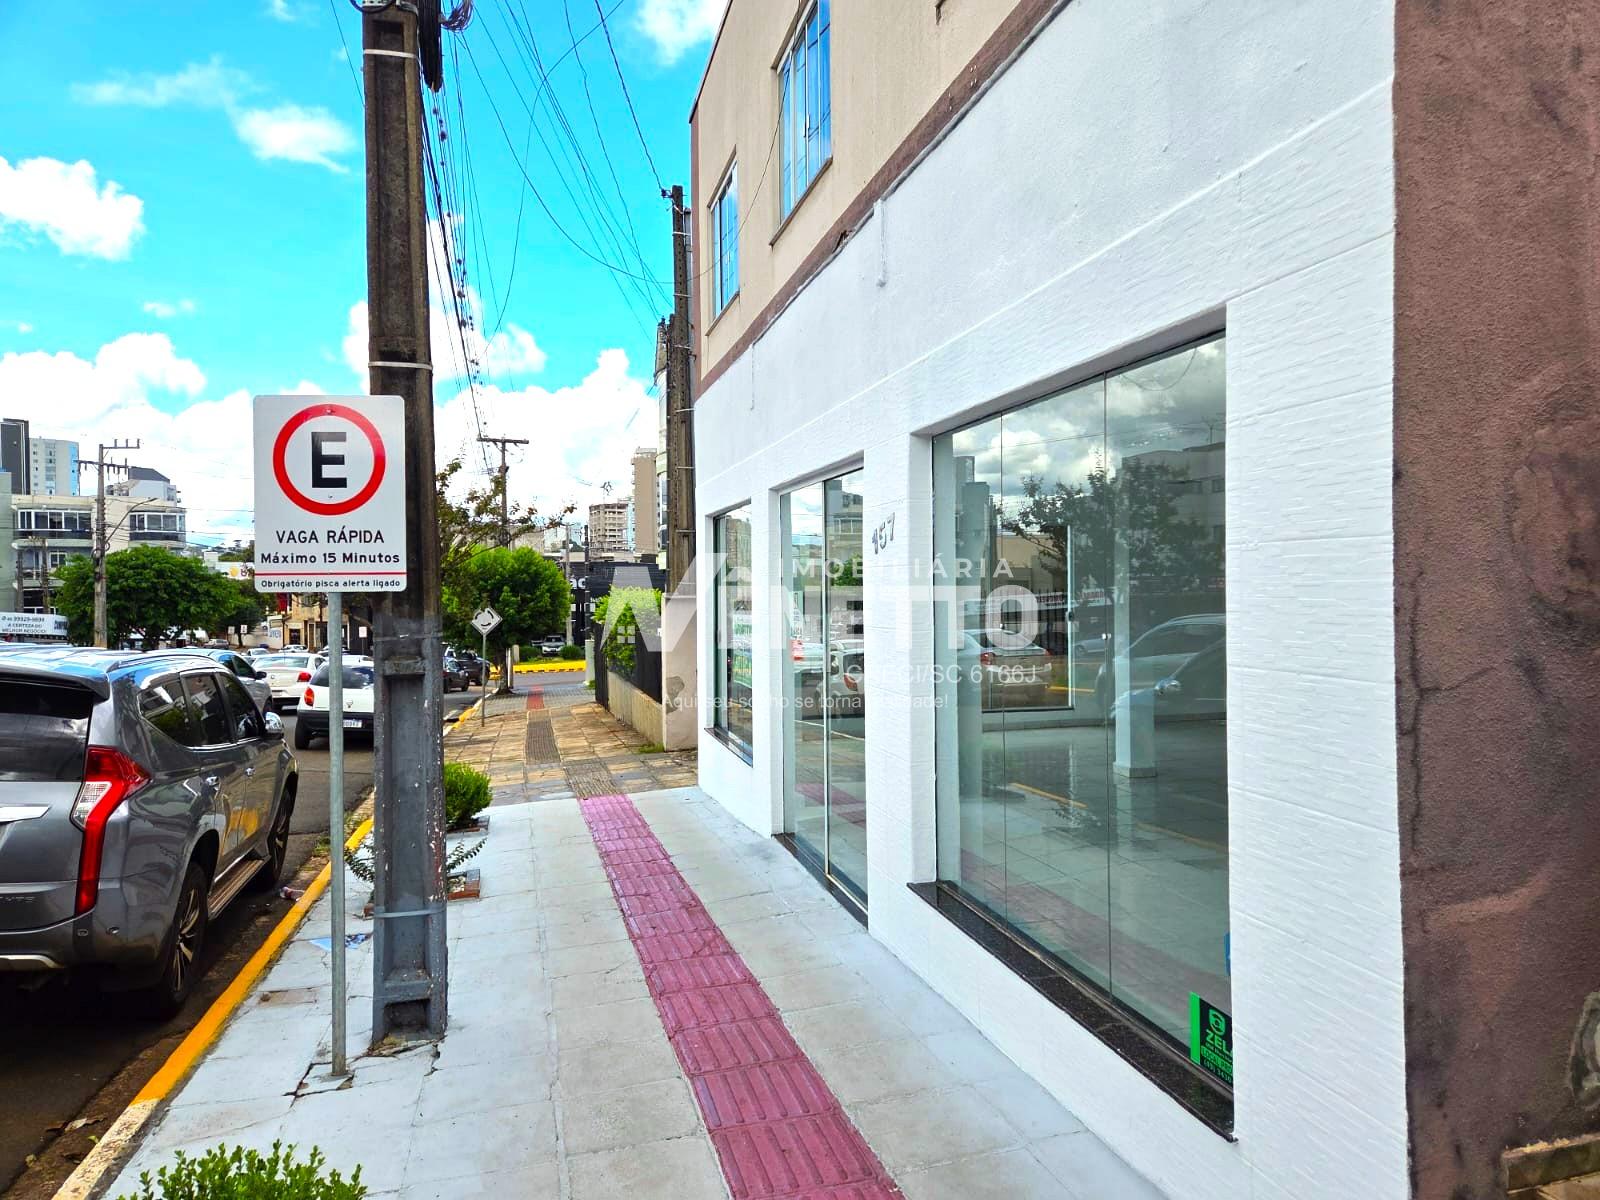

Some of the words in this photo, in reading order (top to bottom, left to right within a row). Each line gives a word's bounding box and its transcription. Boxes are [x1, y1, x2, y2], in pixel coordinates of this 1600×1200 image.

[311, 431, 348, 489] E
[275, 530, 319, 544] VAGA
[327, 525, 385, 544] RÁPIDA
[260, 552, 317, 564] Máximo
[323, 552, 337, 563] 15
[342, 552, 400, 563] Minutos
[261, 579, 313, 589] Obrigatório
[315, 579, 340, 588] pisca
[342, 579, 370, 587] alerta
[373, 579, 401, 588] ligado
